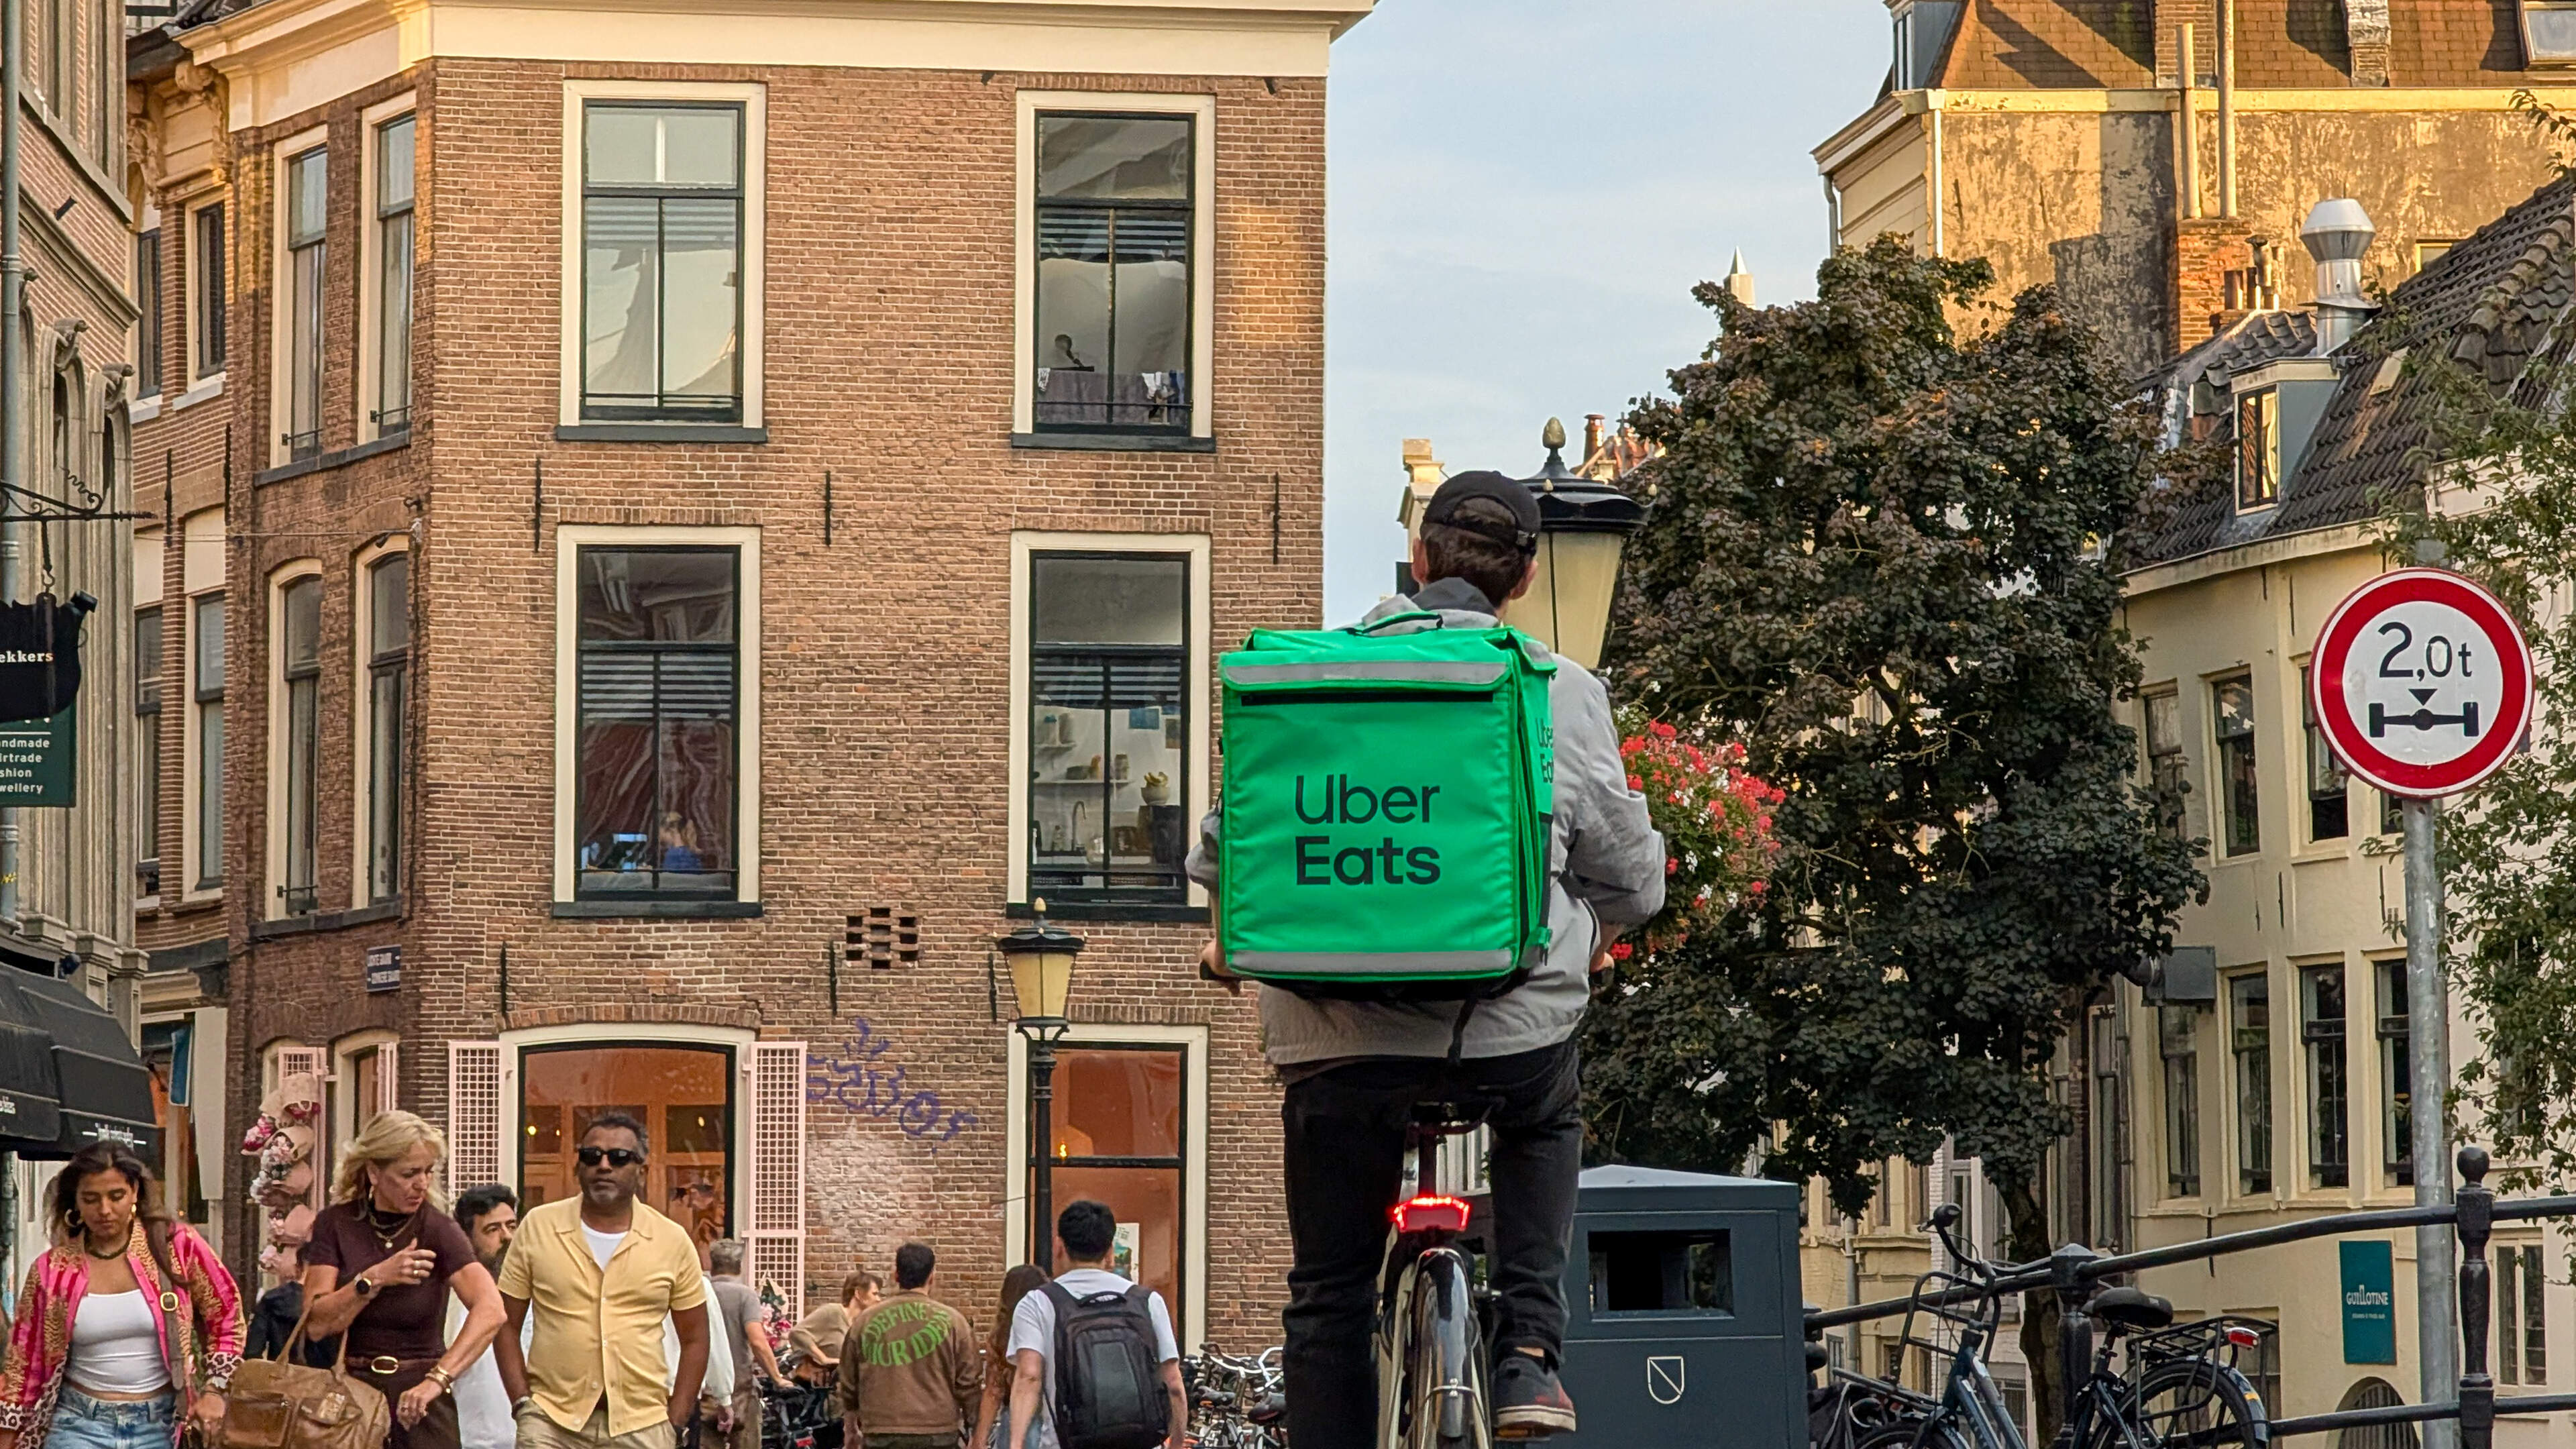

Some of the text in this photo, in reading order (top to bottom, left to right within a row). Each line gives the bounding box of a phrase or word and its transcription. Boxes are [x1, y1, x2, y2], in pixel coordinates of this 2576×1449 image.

[0, 738, 50, 747] ndmade
[1295, 773, 1441, 825] Uber
[1295, 835, 1441, 886] Eats
[2346, 1284, 2389, 1305] GUILLOTINE
